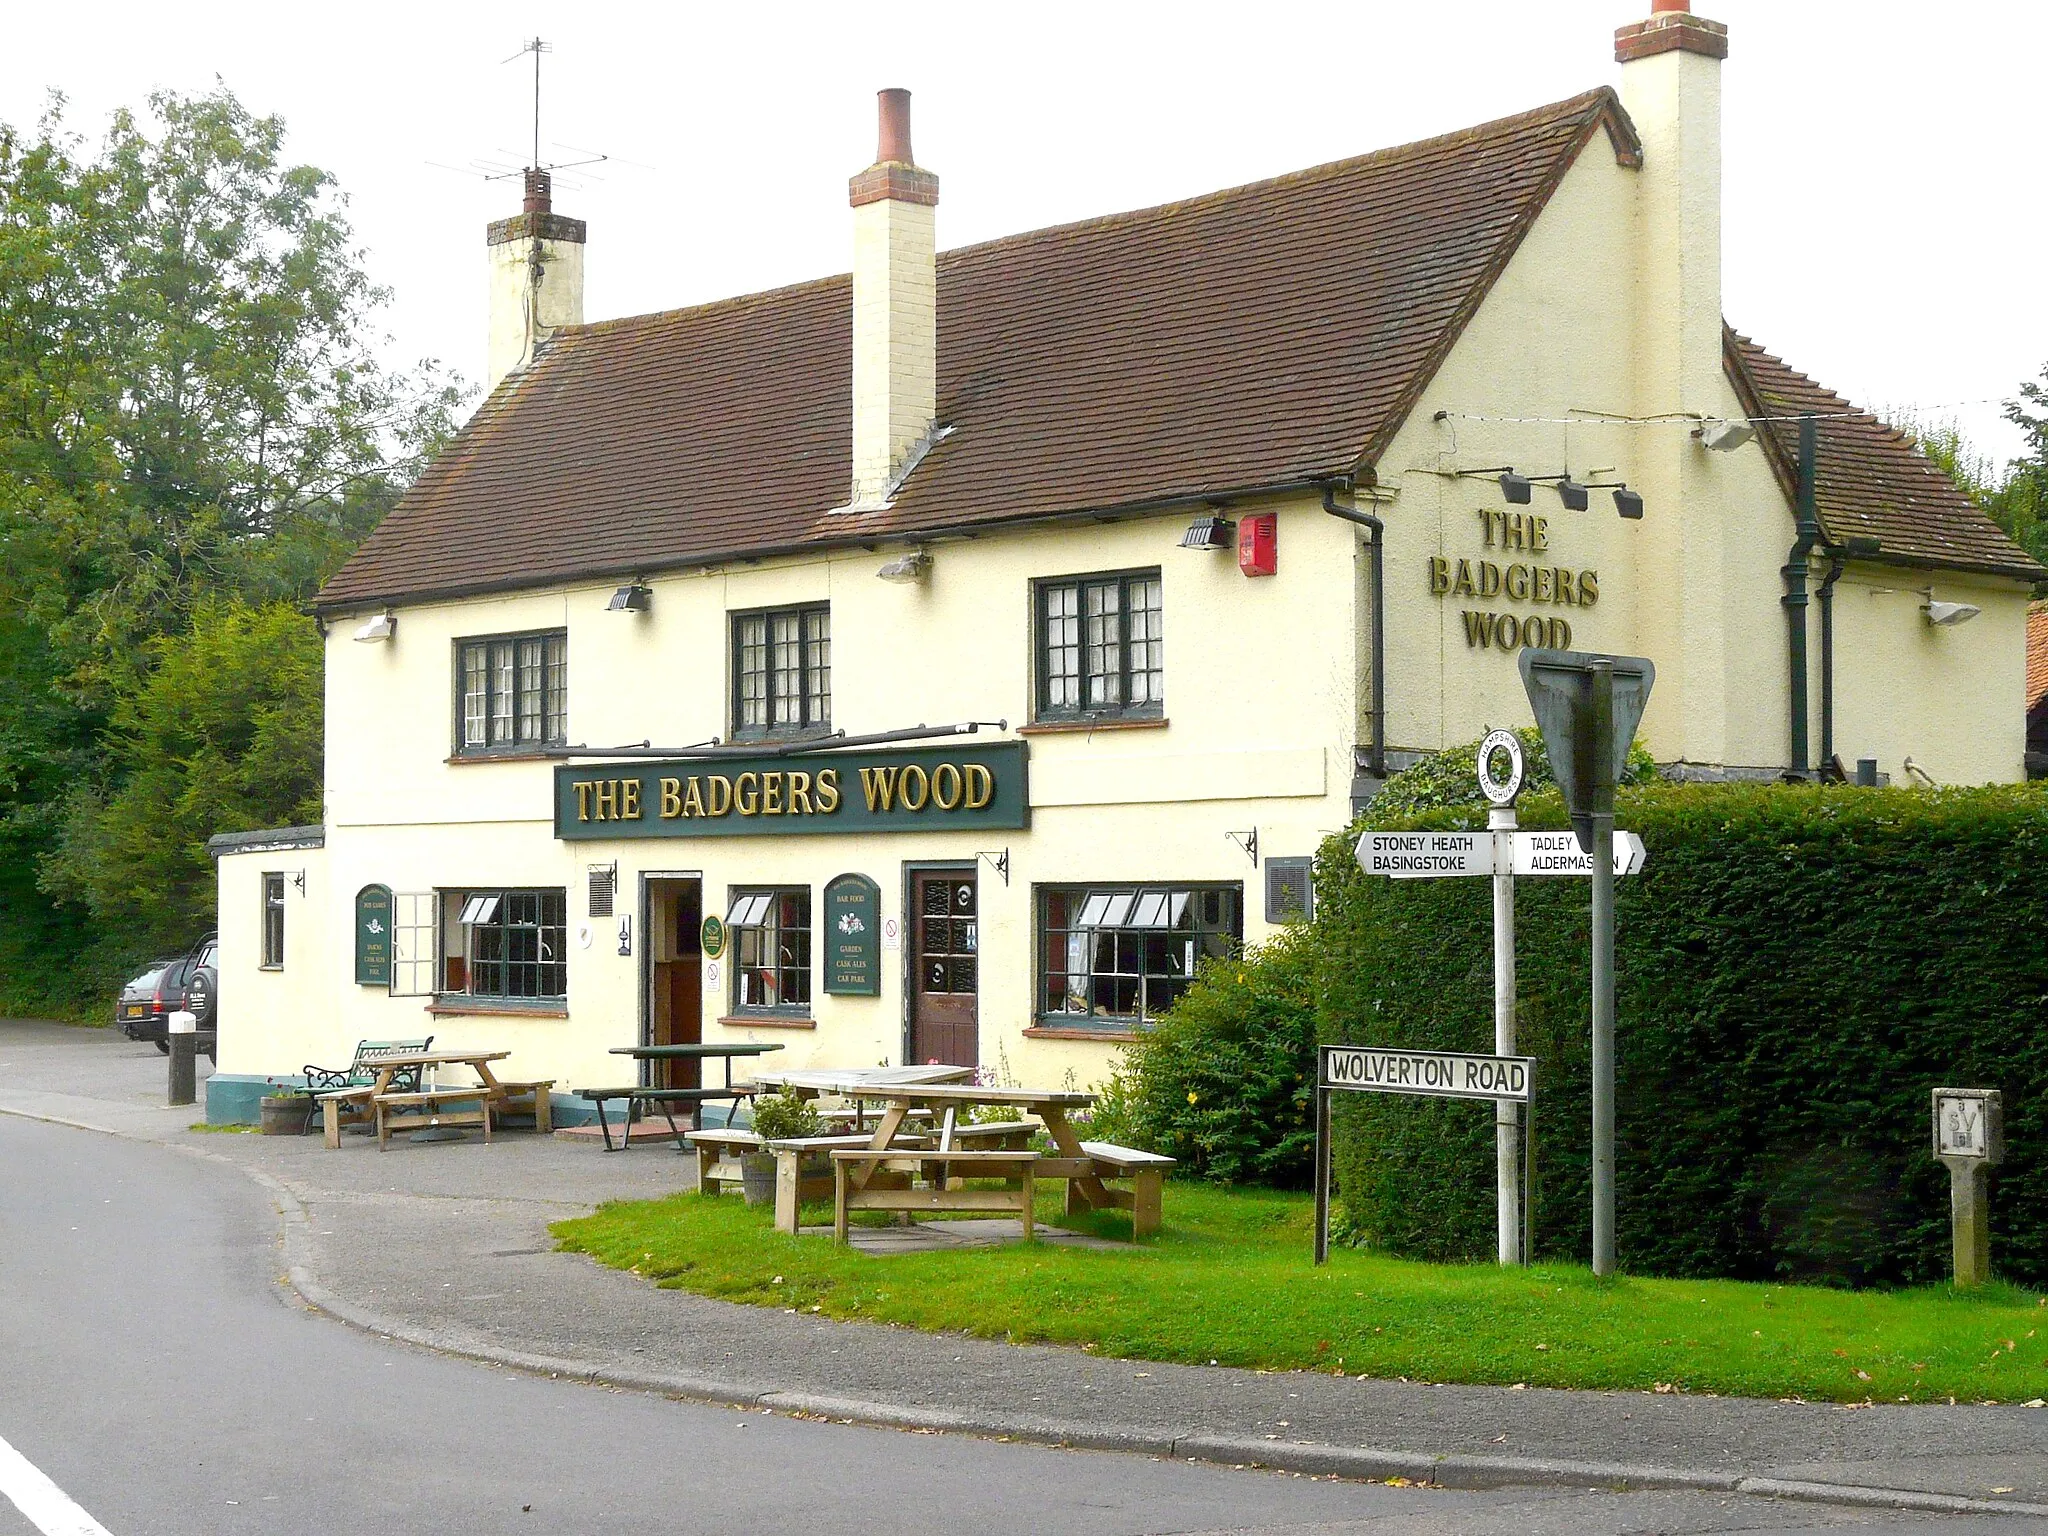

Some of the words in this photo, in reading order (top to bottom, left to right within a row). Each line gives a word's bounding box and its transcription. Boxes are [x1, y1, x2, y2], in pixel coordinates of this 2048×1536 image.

[1479, 508, 1549, 551] THE
[1430, 555, 1600, 607] BADGERS
[1462, 610, 1572, 650] WOOD
[1481, 732, 1519, 759] HAMPSHIRE
[572, 778, 642, 821] THE
[658, 767, 841, 819] BADGERS
[858, 763, 995, 812] WOOD
[1480, 773, 1520, 799] BAUGHURST
[1372, 837, 1426, 851] STONEY
[1432, 837, 1473, 851] HEATH
[1530, 836, 1572, 850] TADLEY
[1373, 856, 1466, 870] BASINGSTOKE
[1531, 855, 1619, 870] ALDERMASN
[1332, 1053, 1454, 1087] WOLVERTON
[1466, 1061, 1525, 1092] ROAD
